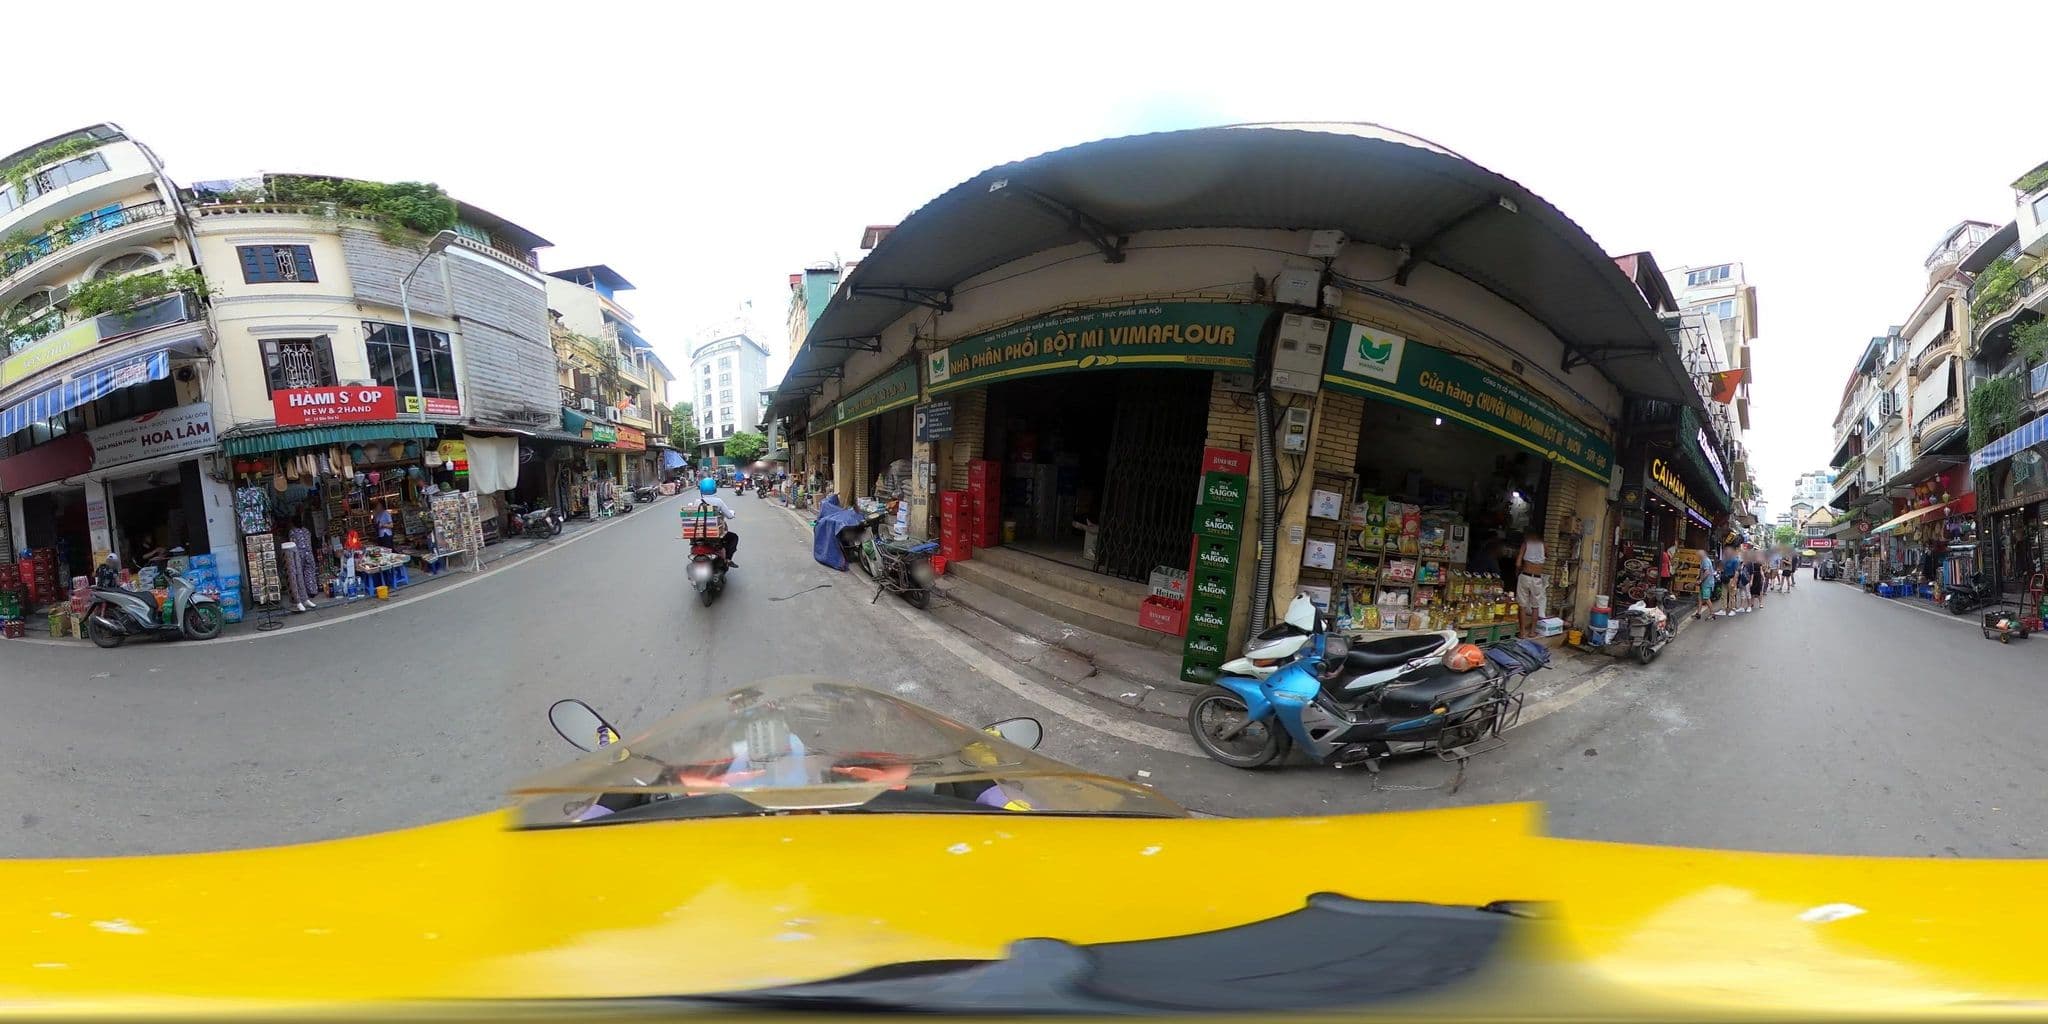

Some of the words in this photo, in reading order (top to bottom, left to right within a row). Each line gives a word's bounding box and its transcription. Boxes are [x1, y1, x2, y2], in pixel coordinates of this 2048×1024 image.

[950, 353, 971, 376] NHÀ
[971, 346, 1002, 370] PHÂN
[1004, 332, 1038, 361] PHỐI
[1043, 329, 1077, 358] BỘT
[1109, 323, 1236, 346] VIMAFLOUR
[1419, 369, 1445, 394] Cửa
[1445, 381, 1474, 408] hàng
[289, 390, 336, 407] HÀMI
[303, 408, 327, 416] NEW
[328, 407, 336, 415] &
[337, 405, 372, 415] 2HAND
[916, 412, 926, 437] P
[141, 429, 174, 447] HOA
[176, 421, 210, 439] LÂM
[1652, 458, 1670, 487] CÁI
[1209, 486, 1239, 498] SAIGON
[1205, 519, 1234, 531] SAIGON
[1200, 552, 1230, 564] SAIGON
[1197, 583, 1226, 596] SAIGON
[1194, 614, 1223, 626] SAIGON
[1189, 640, 1218, 652] SAIGON
